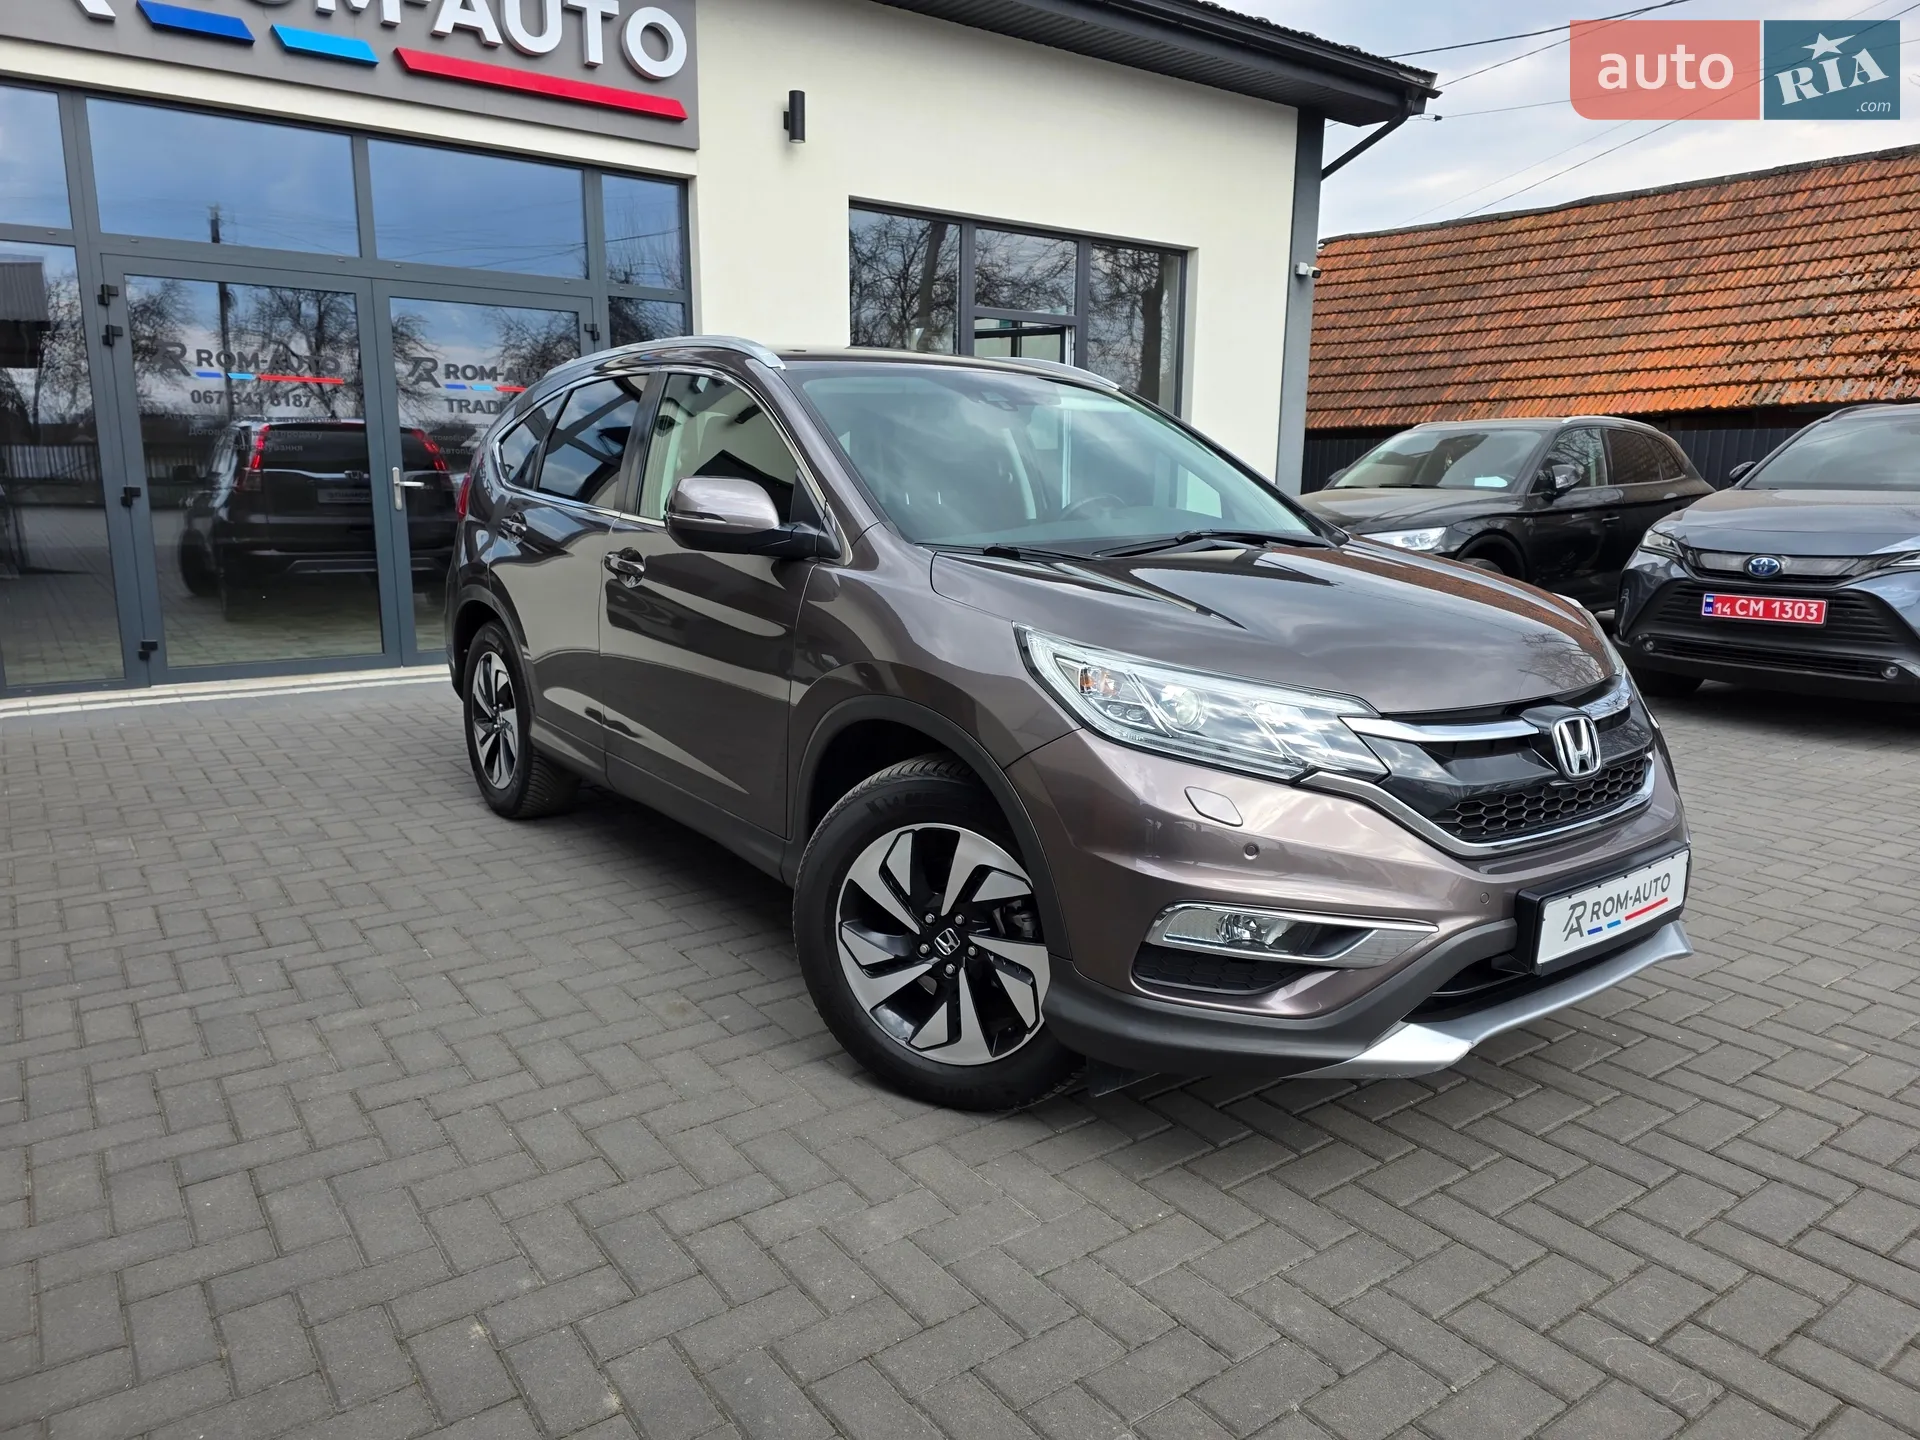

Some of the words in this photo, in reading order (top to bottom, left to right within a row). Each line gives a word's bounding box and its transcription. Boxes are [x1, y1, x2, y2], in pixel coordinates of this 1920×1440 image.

[196, 349, 341, 374] ROM-AUTO
[190, 389, 224, 405] 067
[1715, 602, 1731, 615] 14
[1735, 599, 1764, 617] CM
[1771, 601, 1818, 620] 1303
[1589, 872, 1671, 922] ROM-AUTO
